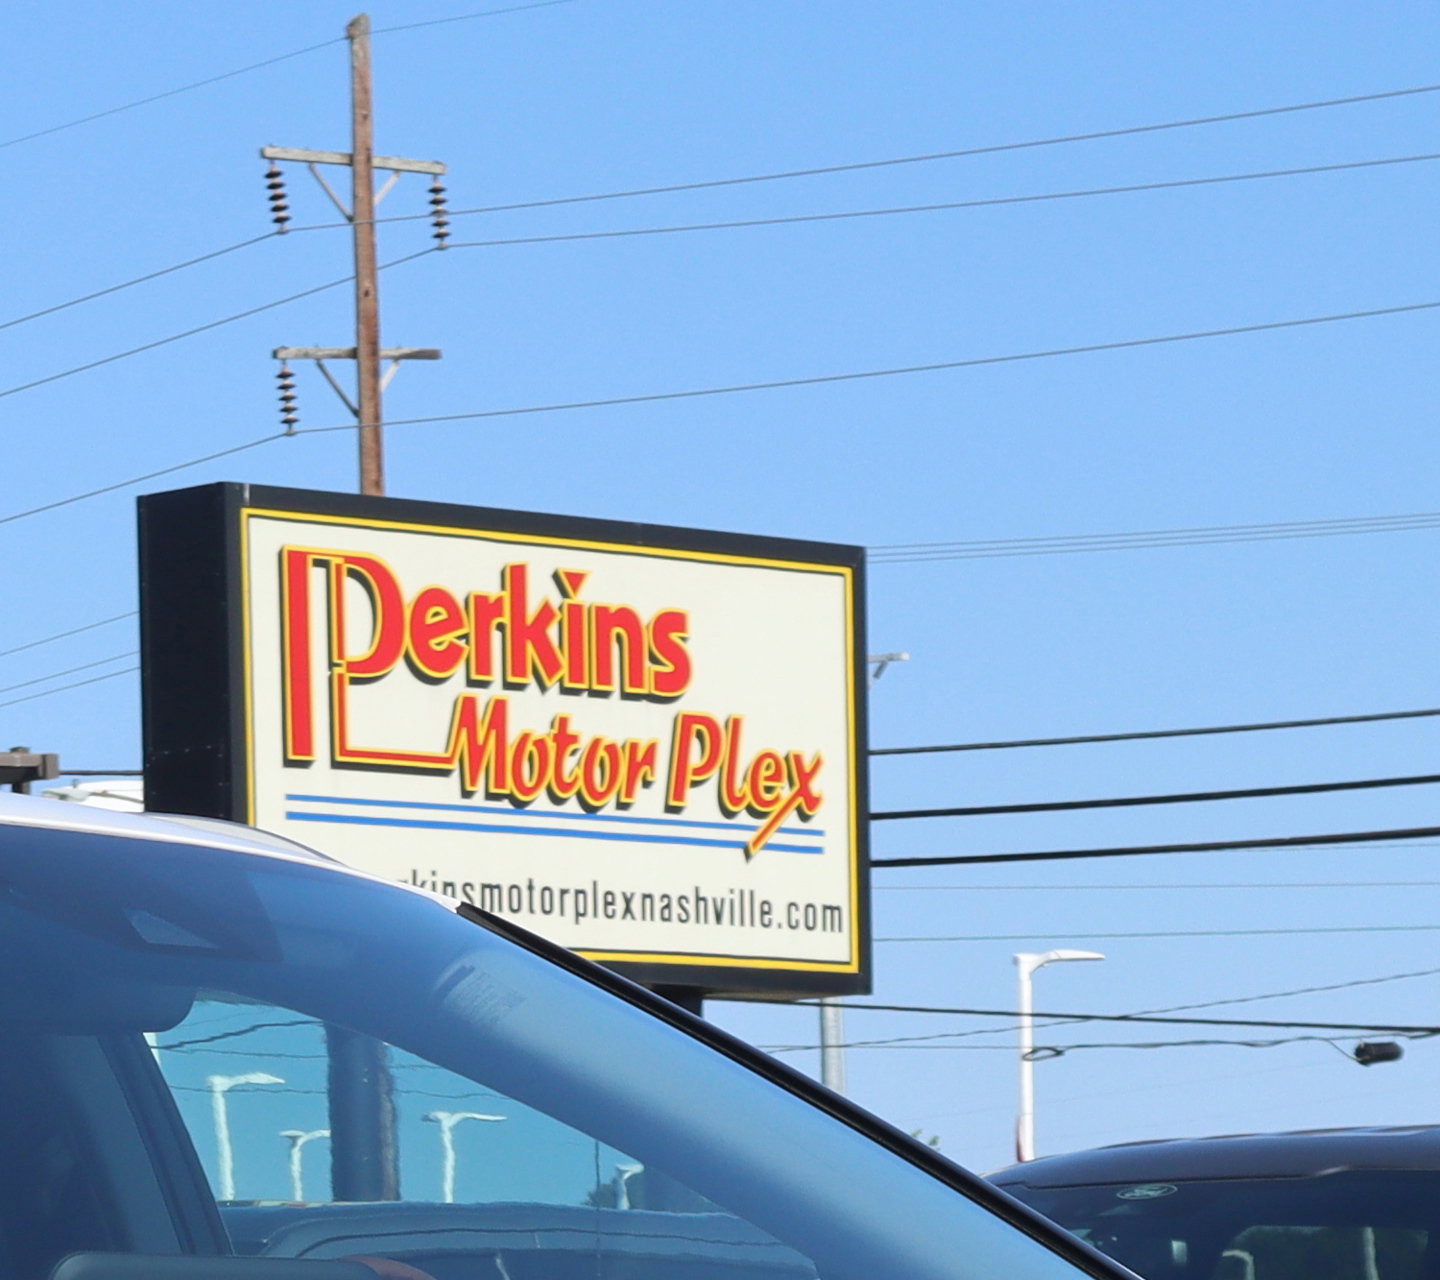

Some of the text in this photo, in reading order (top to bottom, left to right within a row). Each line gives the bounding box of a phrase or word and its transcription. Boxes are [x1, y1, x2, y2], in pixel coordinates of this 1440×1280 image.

[280, 545, 694, 764] Perkins
[450, 693, 826, 857] Motor Plex
[397, 868, 843, 934] kinsmotorplexnashville.com
